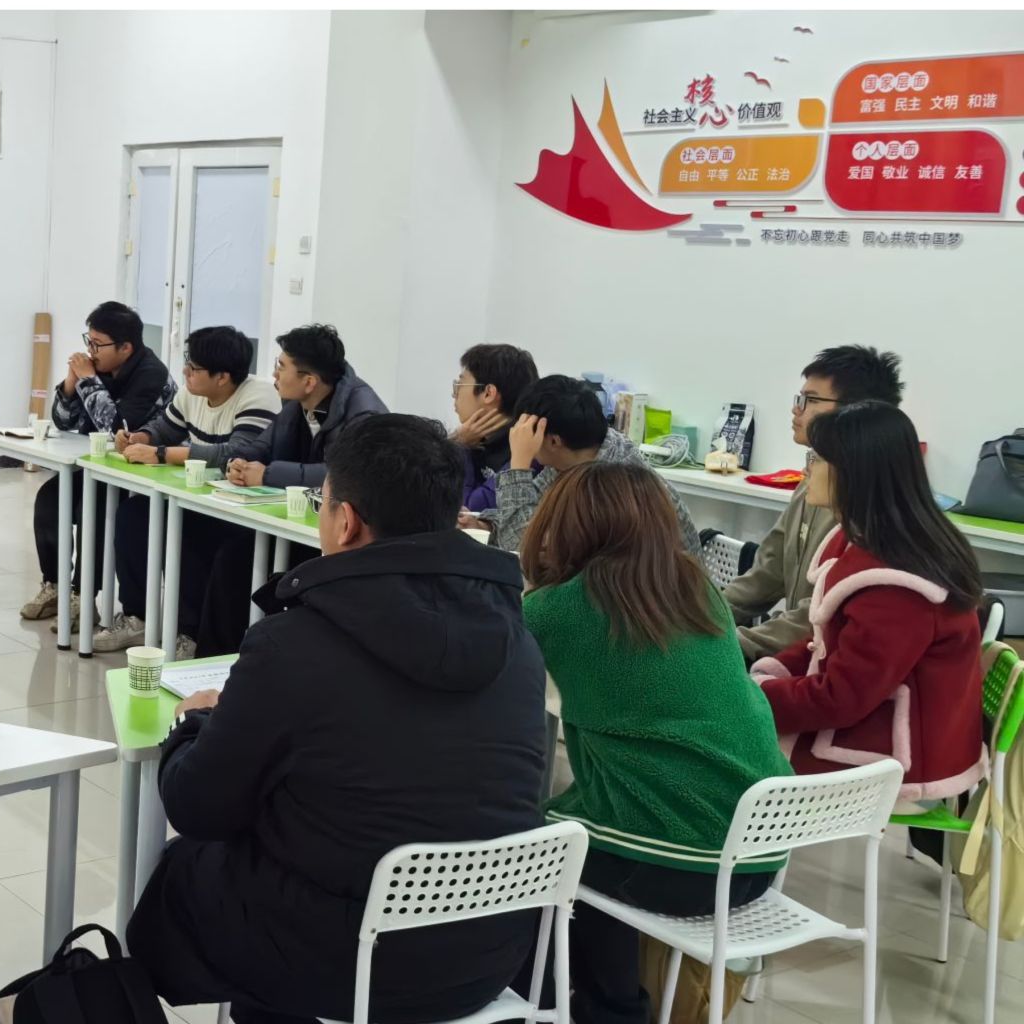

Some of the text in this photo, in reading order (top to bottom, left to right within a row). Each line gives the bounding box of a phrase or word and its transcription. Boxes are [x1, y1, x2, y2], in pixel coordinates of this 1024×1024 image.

[864, 74, 927, 90] 国家层面
[860, 93, 998, 113] 富强 民主 文明 和谐
[682, 149, 733, 162] 社会层面
[855, 142, 918, 157] 个人层面
[679, 168, 791, 182] 自由 平等 公正 法治
[848, 165, 983, 180] 爱国 敬业 诚信 友善
[761, 228, 962, 246] 不忘初心跟党走 同心共筑中国梦
